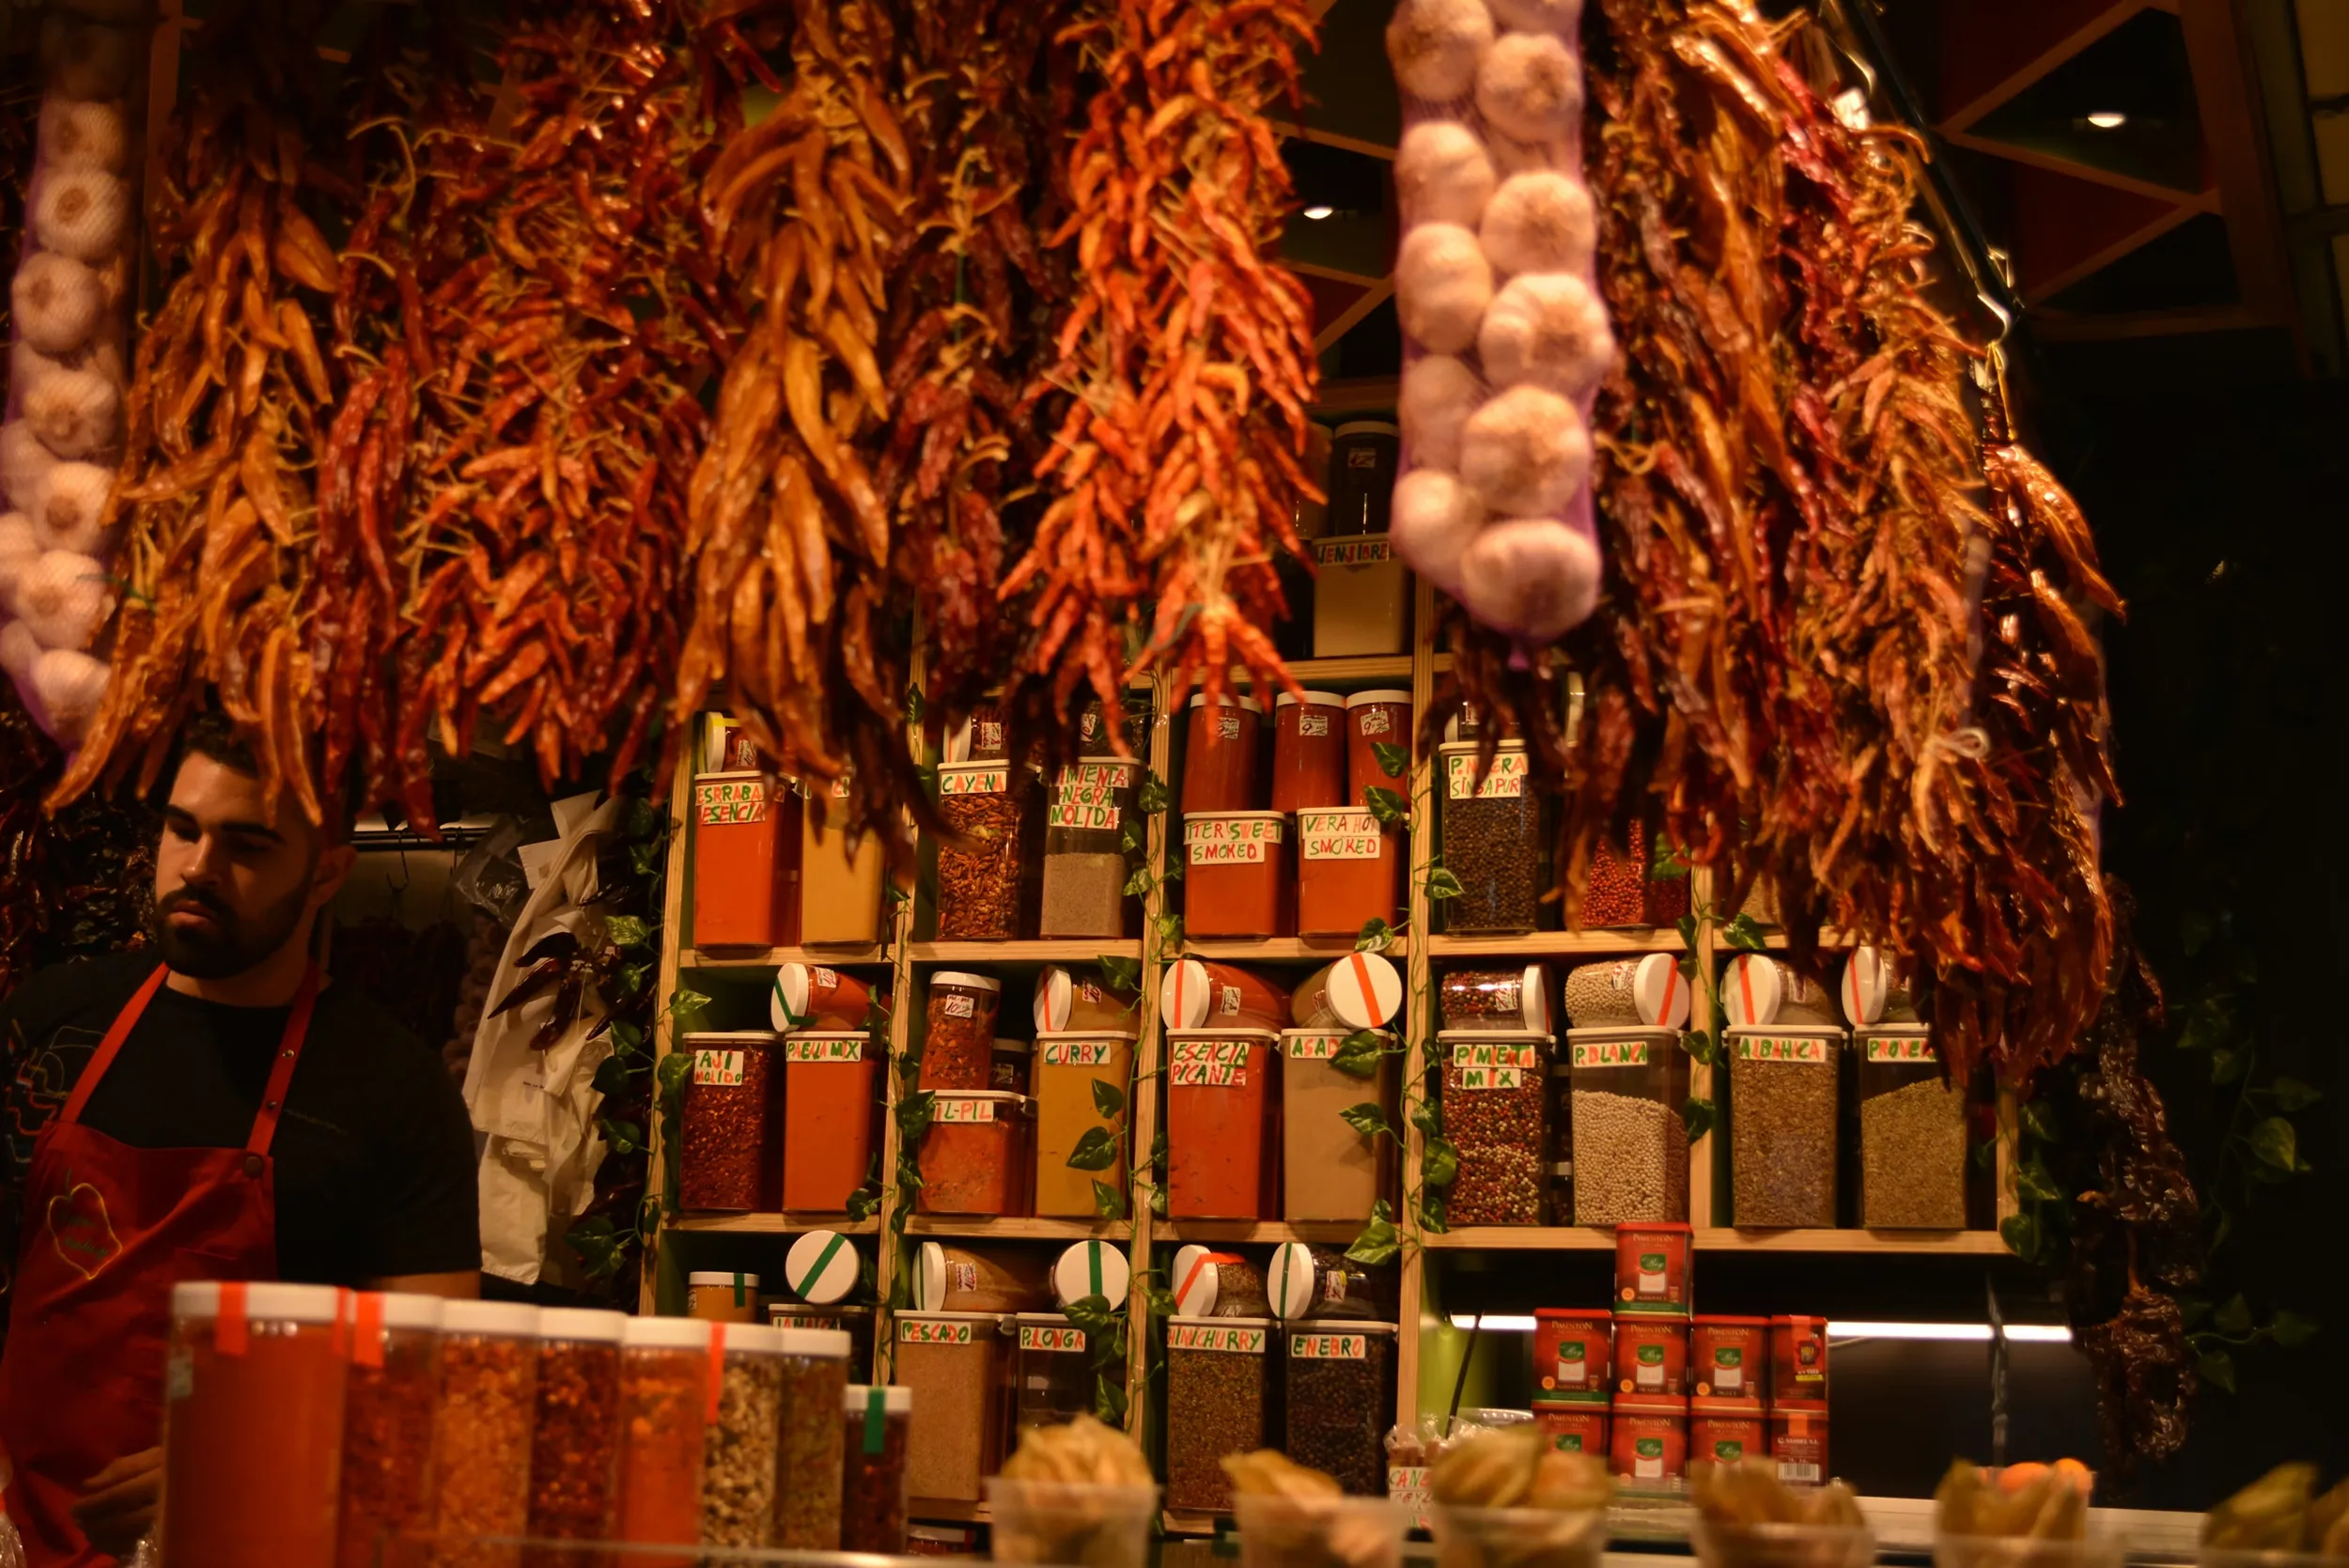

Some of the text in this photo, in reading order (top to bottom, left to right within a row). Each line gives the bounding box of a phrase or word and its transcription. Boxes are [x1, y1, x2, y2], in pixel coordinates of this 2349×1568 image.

[942, 773, 1003, 793] CAYENA
[1059, 764, 1126, 788] IMIENTA
[702, 802, 764, 823] ESENCIA
[1050, 805, 1117, 830] MOLIDA
[1229, 821, 1283, 840] SWEET
[1306, 815, 1347, 832] VERA
[1193, 843, 1257, 862] SMOKED
[1310, 838, 1377, 856] SMOKED
[831, 1039, 859, 1060] MIX
[1045, 1043, 1107, 1064] CURRY
[1174, 1041, 1248, 1066] ESENCIA
[1292, 1036, 1340, 1057] ASAD
[694, 1069, 742, 1084] MOLIDO
[1172, 1063, 1247, 1086] PICANTE
[1465, 1067, 1514, 1088] MIX
[935, 1099, 992, 1120] IL-PIL
[902, 1321, 969, 1343] PESCADO
[1168, 1325, 1262, 1351] HIMICHURRY
[1293, 1337, 1362, 1358] ENEBRO
